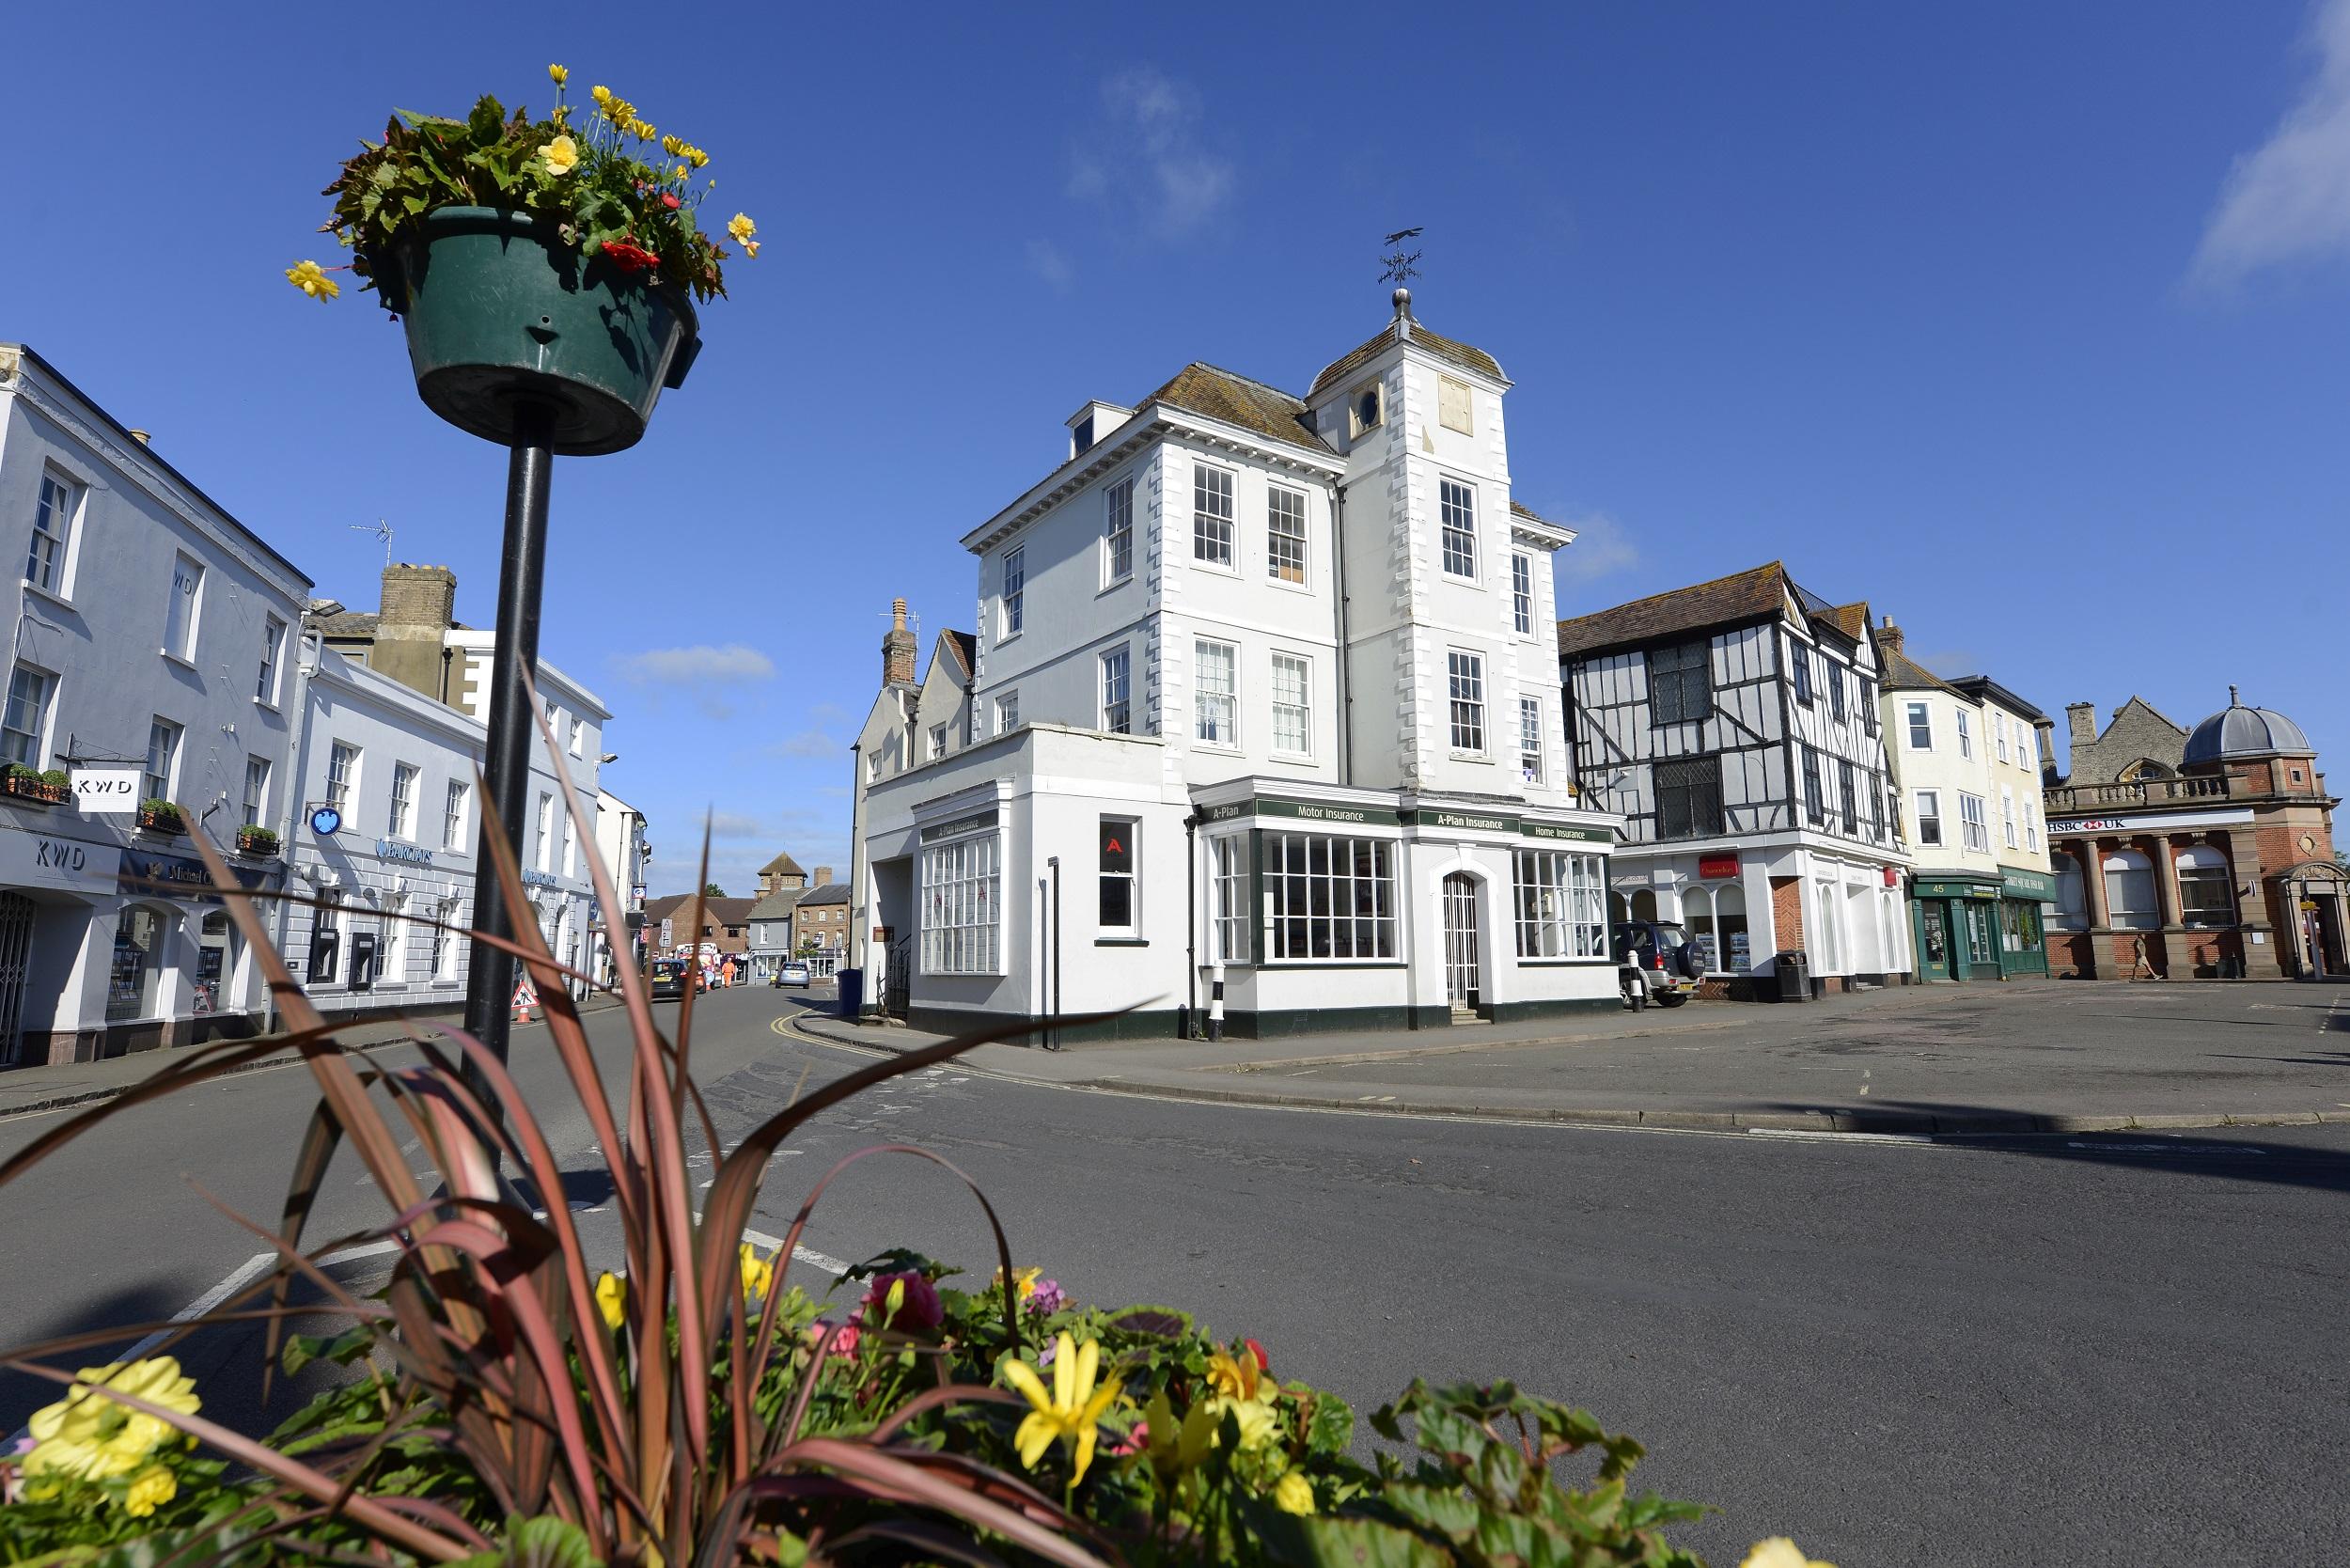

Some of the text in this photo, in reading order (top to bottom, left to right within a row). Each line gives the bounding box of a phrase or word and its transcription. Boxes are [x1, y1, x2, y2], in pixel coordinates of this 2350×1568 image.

[78, 779, 133, 794] KWD
[1213, 806, 1239, 819] A-Plan
[1298, 806, 1364, 822] Motor Insurance
[954, 819, 979, 833] Insurance
[1437, 814, 1503, 830] A-Plan Insurance
[2047, 819, 2126, 832] HSBC UK
[1535, 826, 1586, 839] Home Insurance
[37, 839, 86, 871] KWD
[387, 842, 432, 864] BARCLAYS
[169, 865, 202, 883] Michael
[1933, 885, 1944, 893] 45
